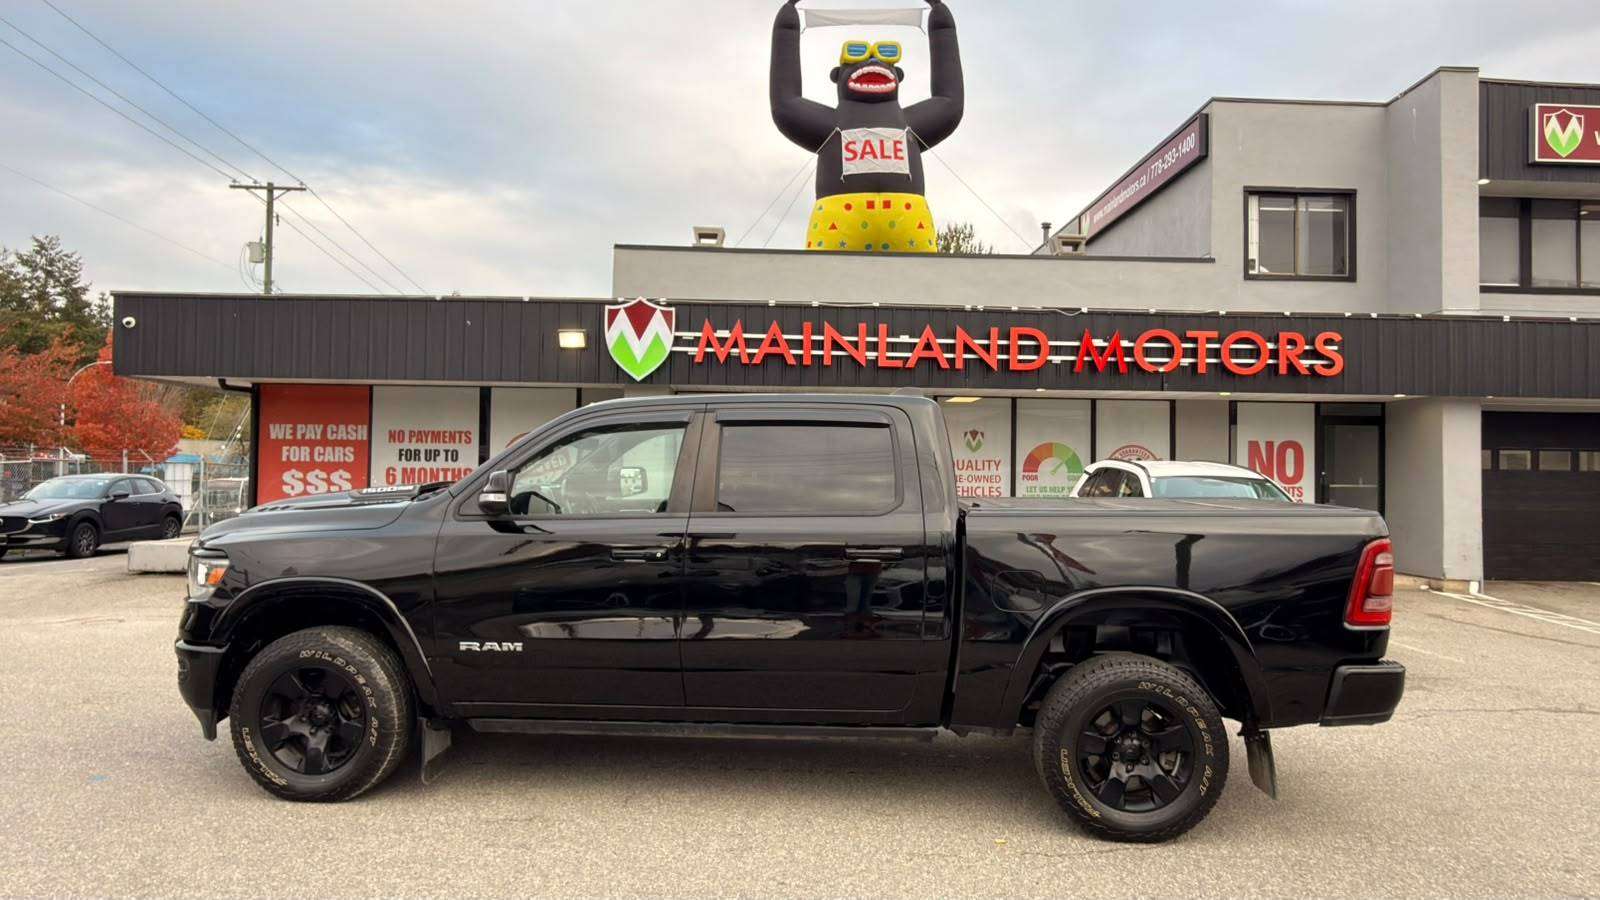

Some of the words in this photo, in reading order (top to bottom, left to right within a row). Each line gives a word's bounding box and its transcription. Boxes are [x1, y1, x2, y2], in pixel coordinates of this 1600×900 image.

[844, 139, 904, 162] SALE
[1151, 132, 1195, 180] 778-293-1400
[694, 318, 1049, 372] MAINLAND
[1073, 328, 1344, 377] MOTORS
[269, 423, 293, 440] WE
[296, 423, 323, 440] PAY
[326, 423, 368, 441] CASH
[388, 429, 405, 444] NO
[408, 430, 472, 445] PAYMENTS
[281, 446, 311, 462] FOR
[313, 446, 355, 463] CARS
[398, 448, 421, 462] FOR
[424, 448, 440, 463] UP
[443, 448, 459, 463] TO
[1247, 440, 1305, 485] NO
[953, 459, 1002, 472] UALITY
[282, 468, 352, 496] $$$
[385, 466, 397, 486] 6
[955, 474, 1002, 484] E-OWNED
[955, 486, 1002, 497] EHICLES
[459, 641, 523, 652] RAM
[1138, 681, 1215, 757] WILDPEAK
